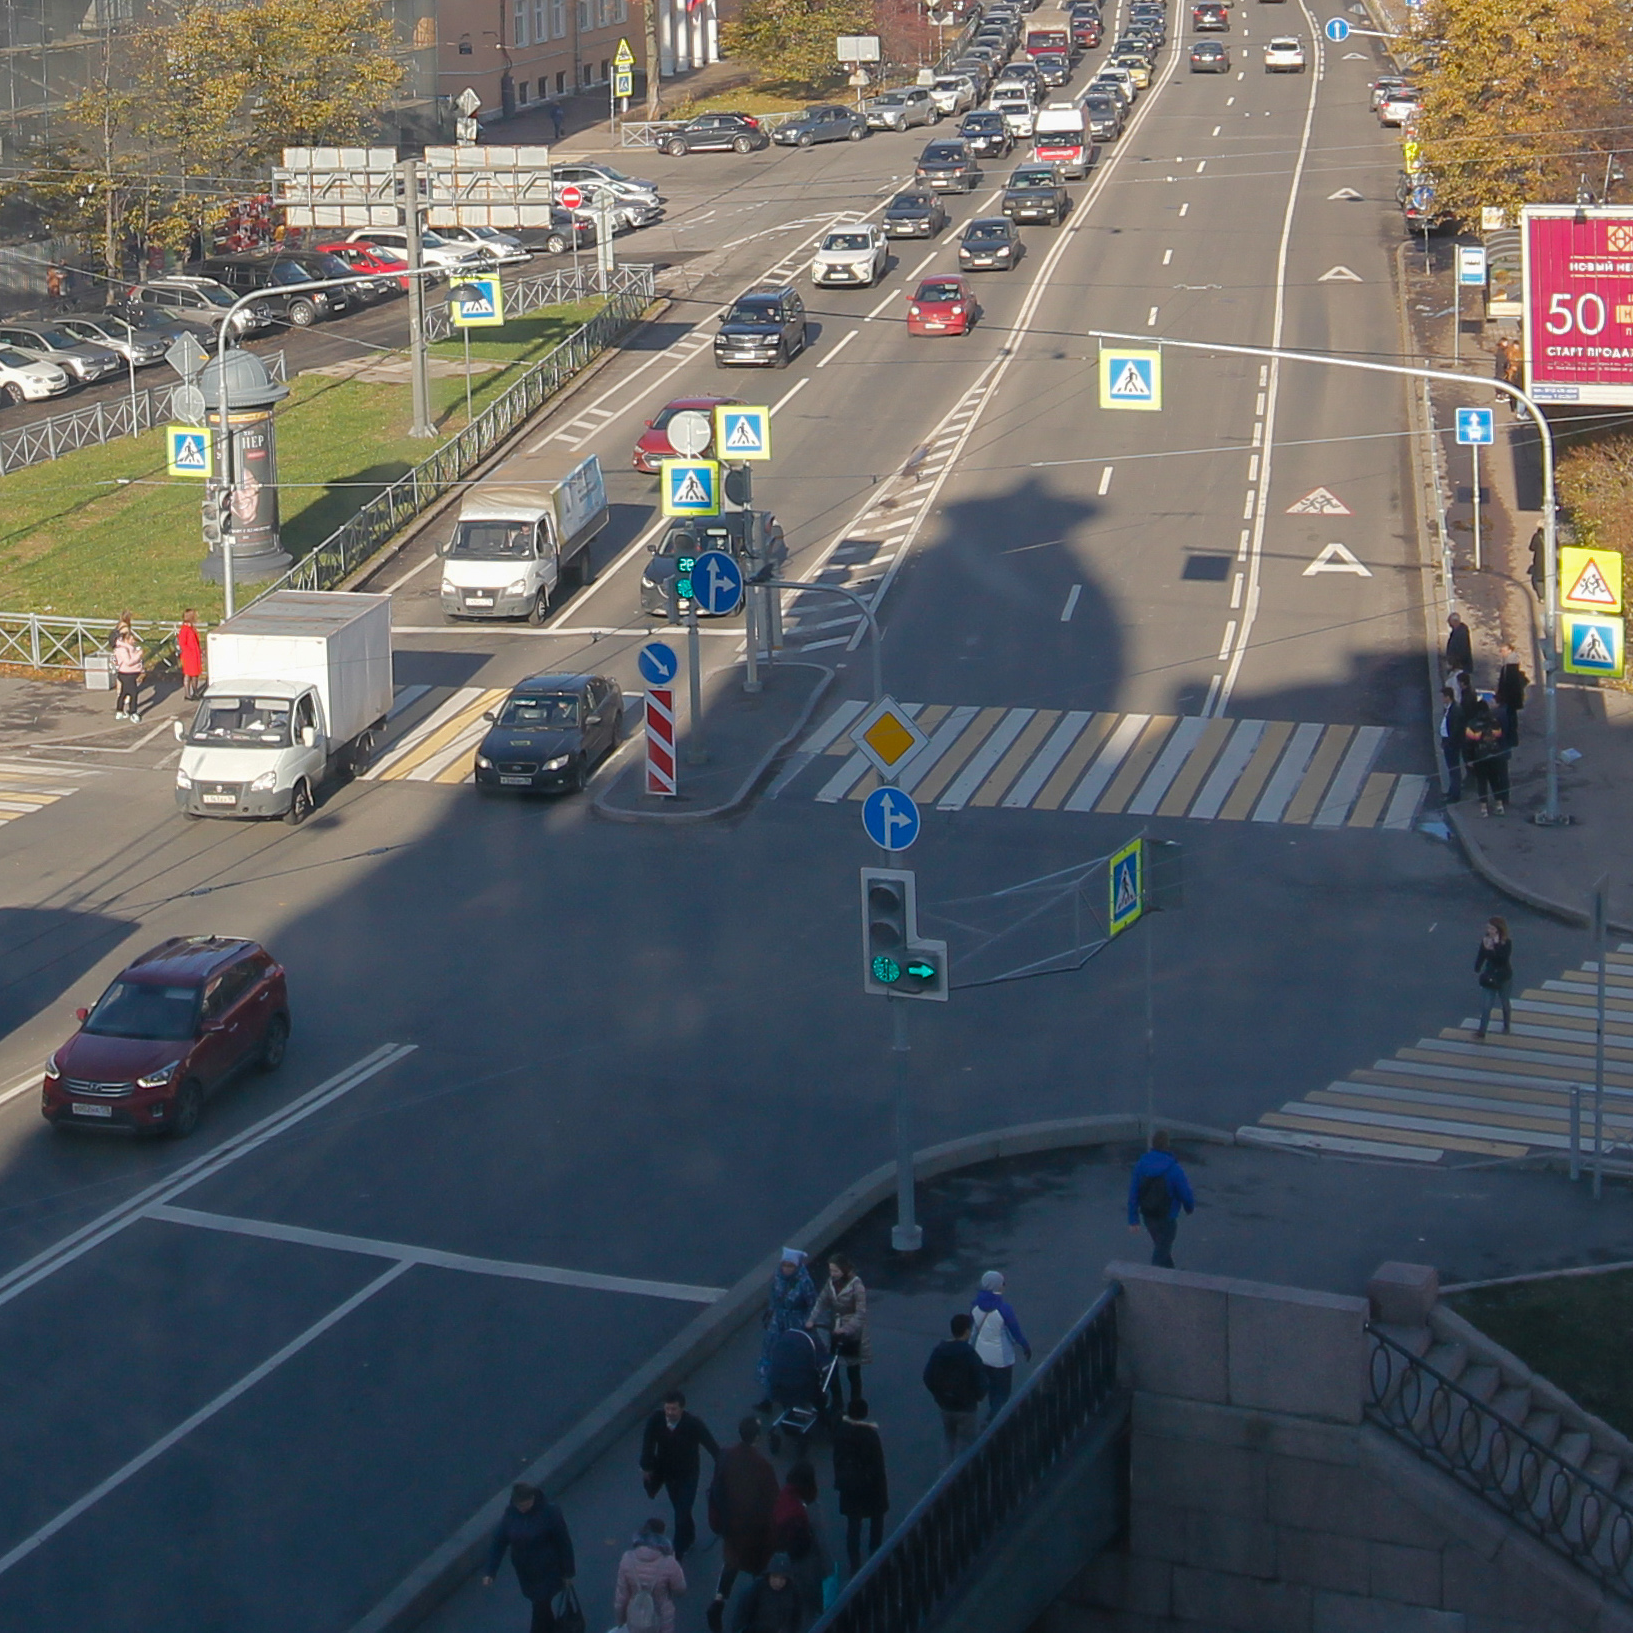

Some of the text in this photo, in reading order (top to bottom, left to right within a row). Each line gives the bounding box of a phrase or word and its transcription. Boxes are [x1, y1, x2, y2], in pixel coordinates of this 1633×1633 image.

[1569, 261, 1614, 272] НОВЫЙ
[1545, 292, 1607, 336] 50
[1546, 346, 1583, 357] СТАРТ
